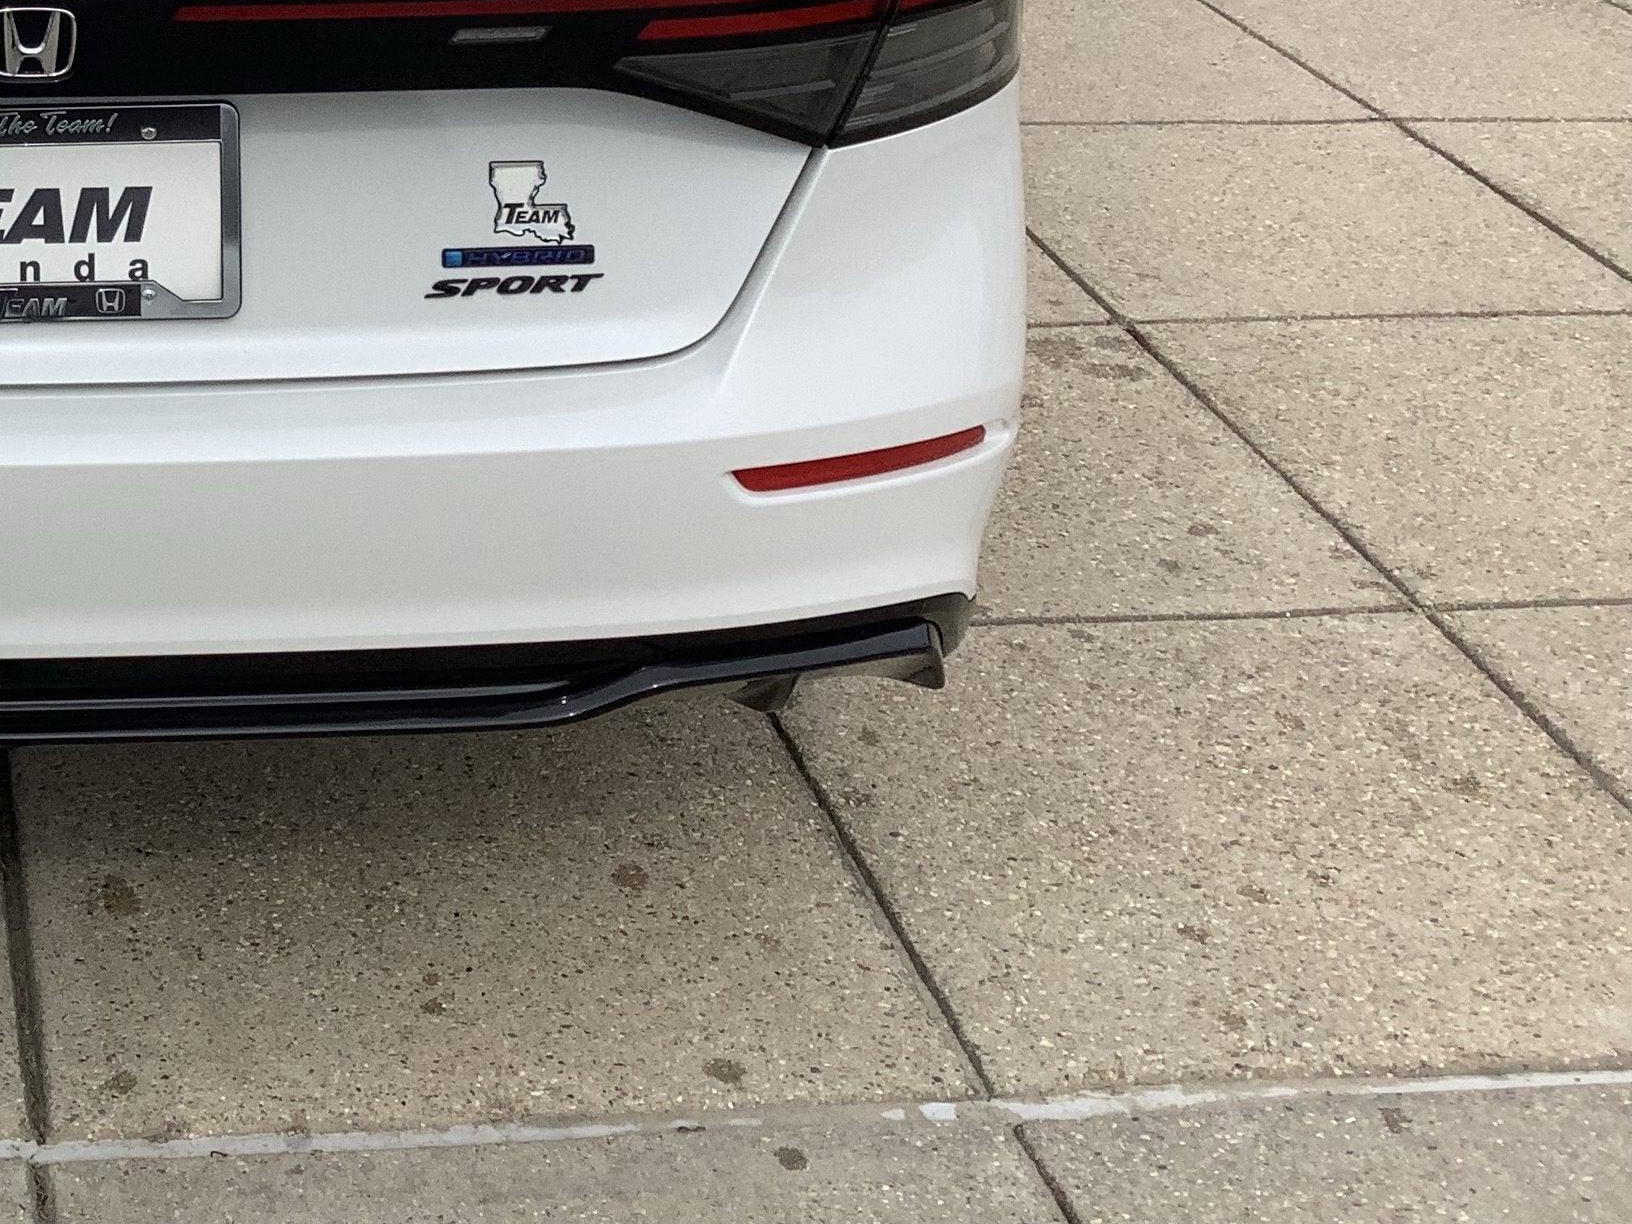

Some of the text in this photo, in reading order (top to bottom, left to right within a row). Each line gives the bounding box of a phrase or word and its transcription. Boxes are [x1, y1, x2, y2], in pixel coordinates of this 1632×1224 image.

[40, 110, 118, 136] Team!
[503, 203, 561, 224] TEAM
[468, 248, 587, 266] HYBRID
[424, 273, 604, 299] SPORT
